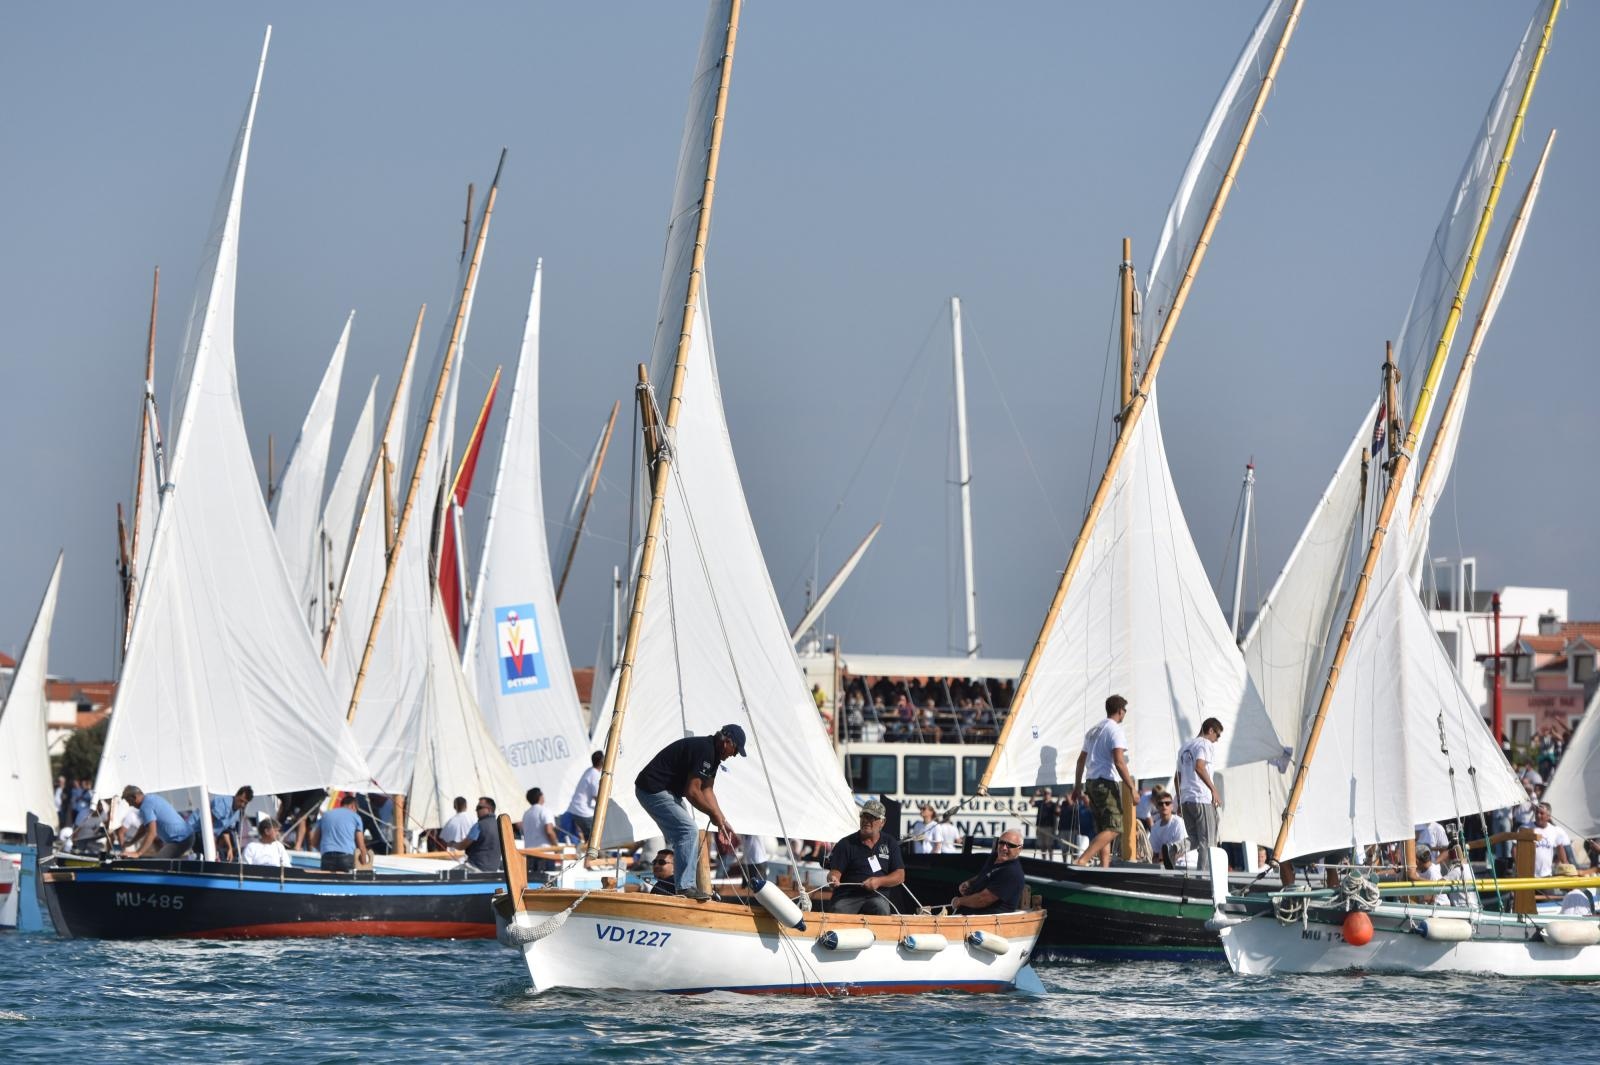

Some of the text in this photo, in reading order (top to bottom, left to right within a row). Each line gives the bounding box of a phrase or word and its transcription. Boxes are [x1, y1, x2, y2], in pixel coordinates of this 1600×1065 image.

[500, 735, 570, 767] ETINA
[116, 892, 184, 910] MU-485
[596, 923, 671, 948] VD1227
